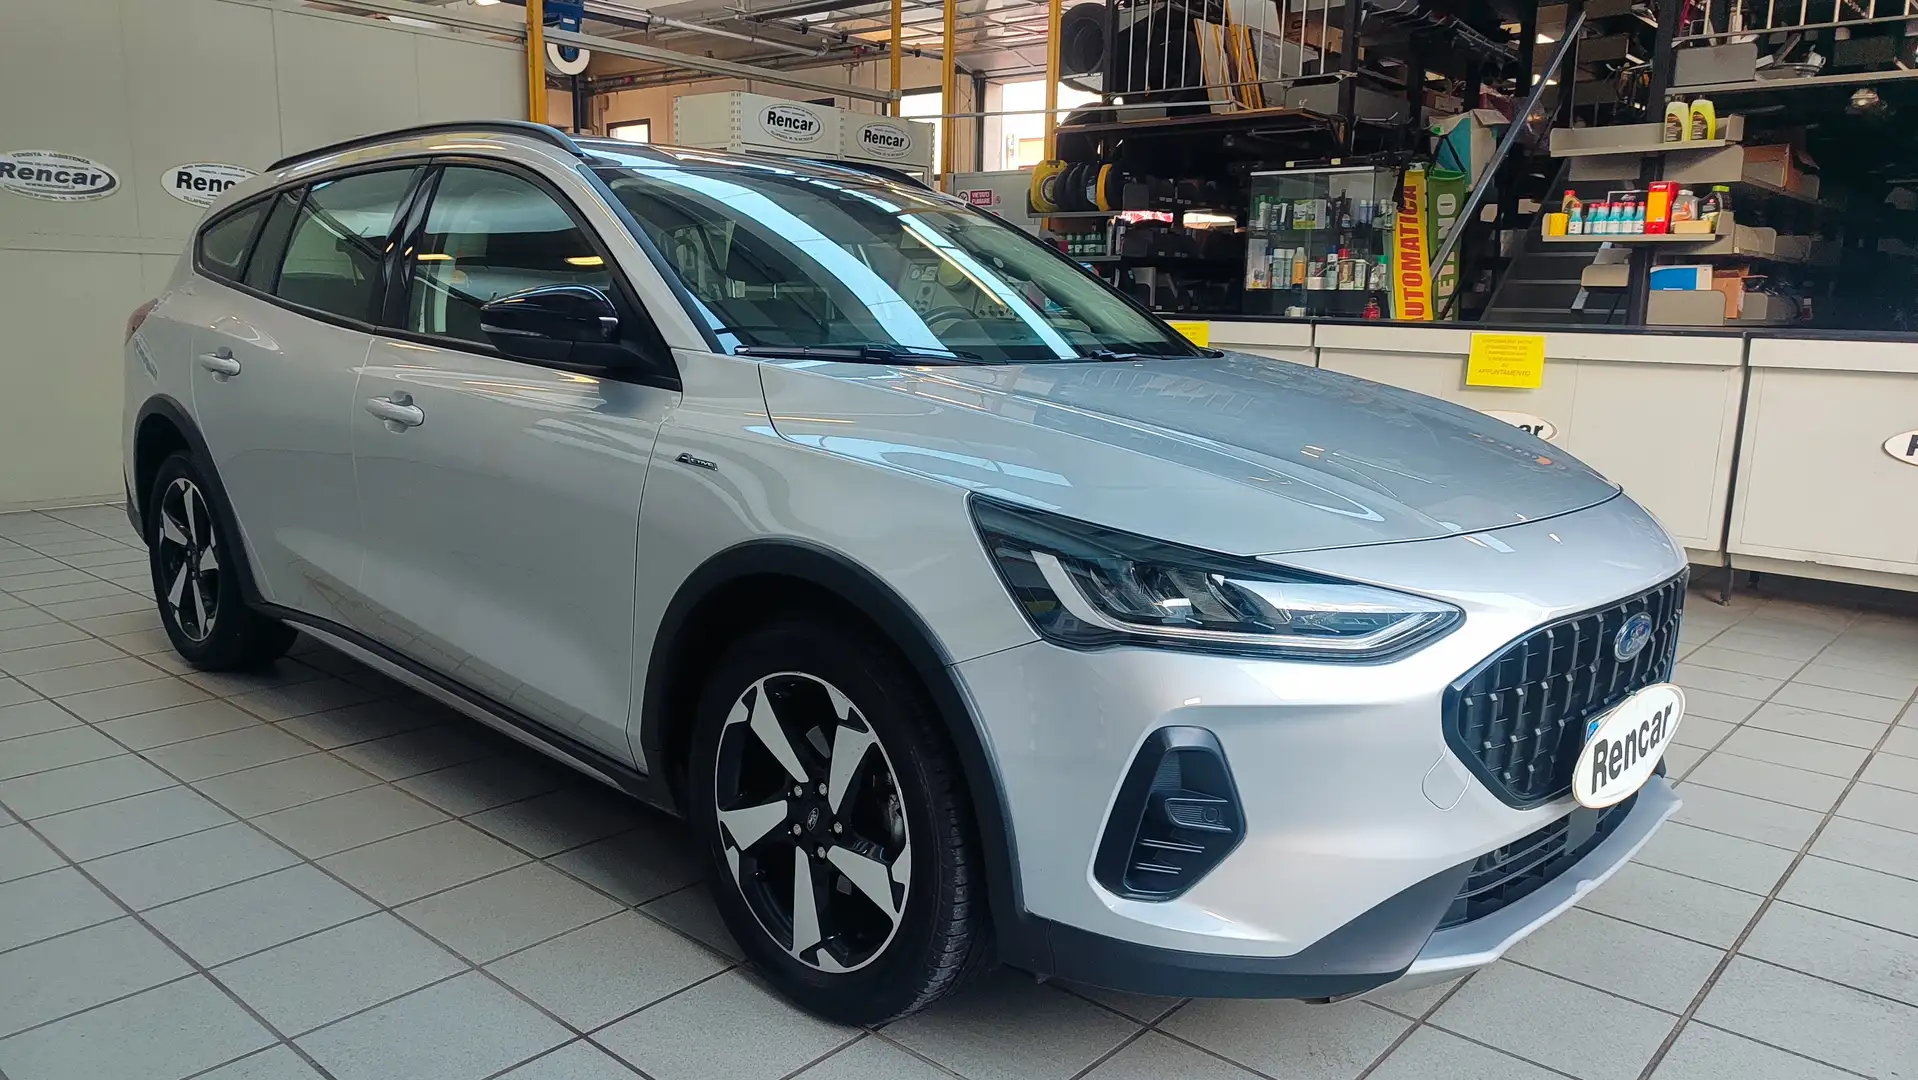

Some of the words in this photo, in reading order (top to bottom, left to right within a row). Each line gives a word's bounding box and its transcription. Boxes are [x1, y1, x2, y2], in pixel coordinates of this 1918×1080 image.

[767, 110, 814, 131] Rencar
[863, 129, 905, 147] Rencar
[48, 152, 91, 165] ASSISTENZA
[0, 161, 102, 186] Rencar
[176, 171, 236, 192] Renc
[1400, 185, 1425, 321] UTOMATICA
[1591, 702, 1673, 796] Rencar
